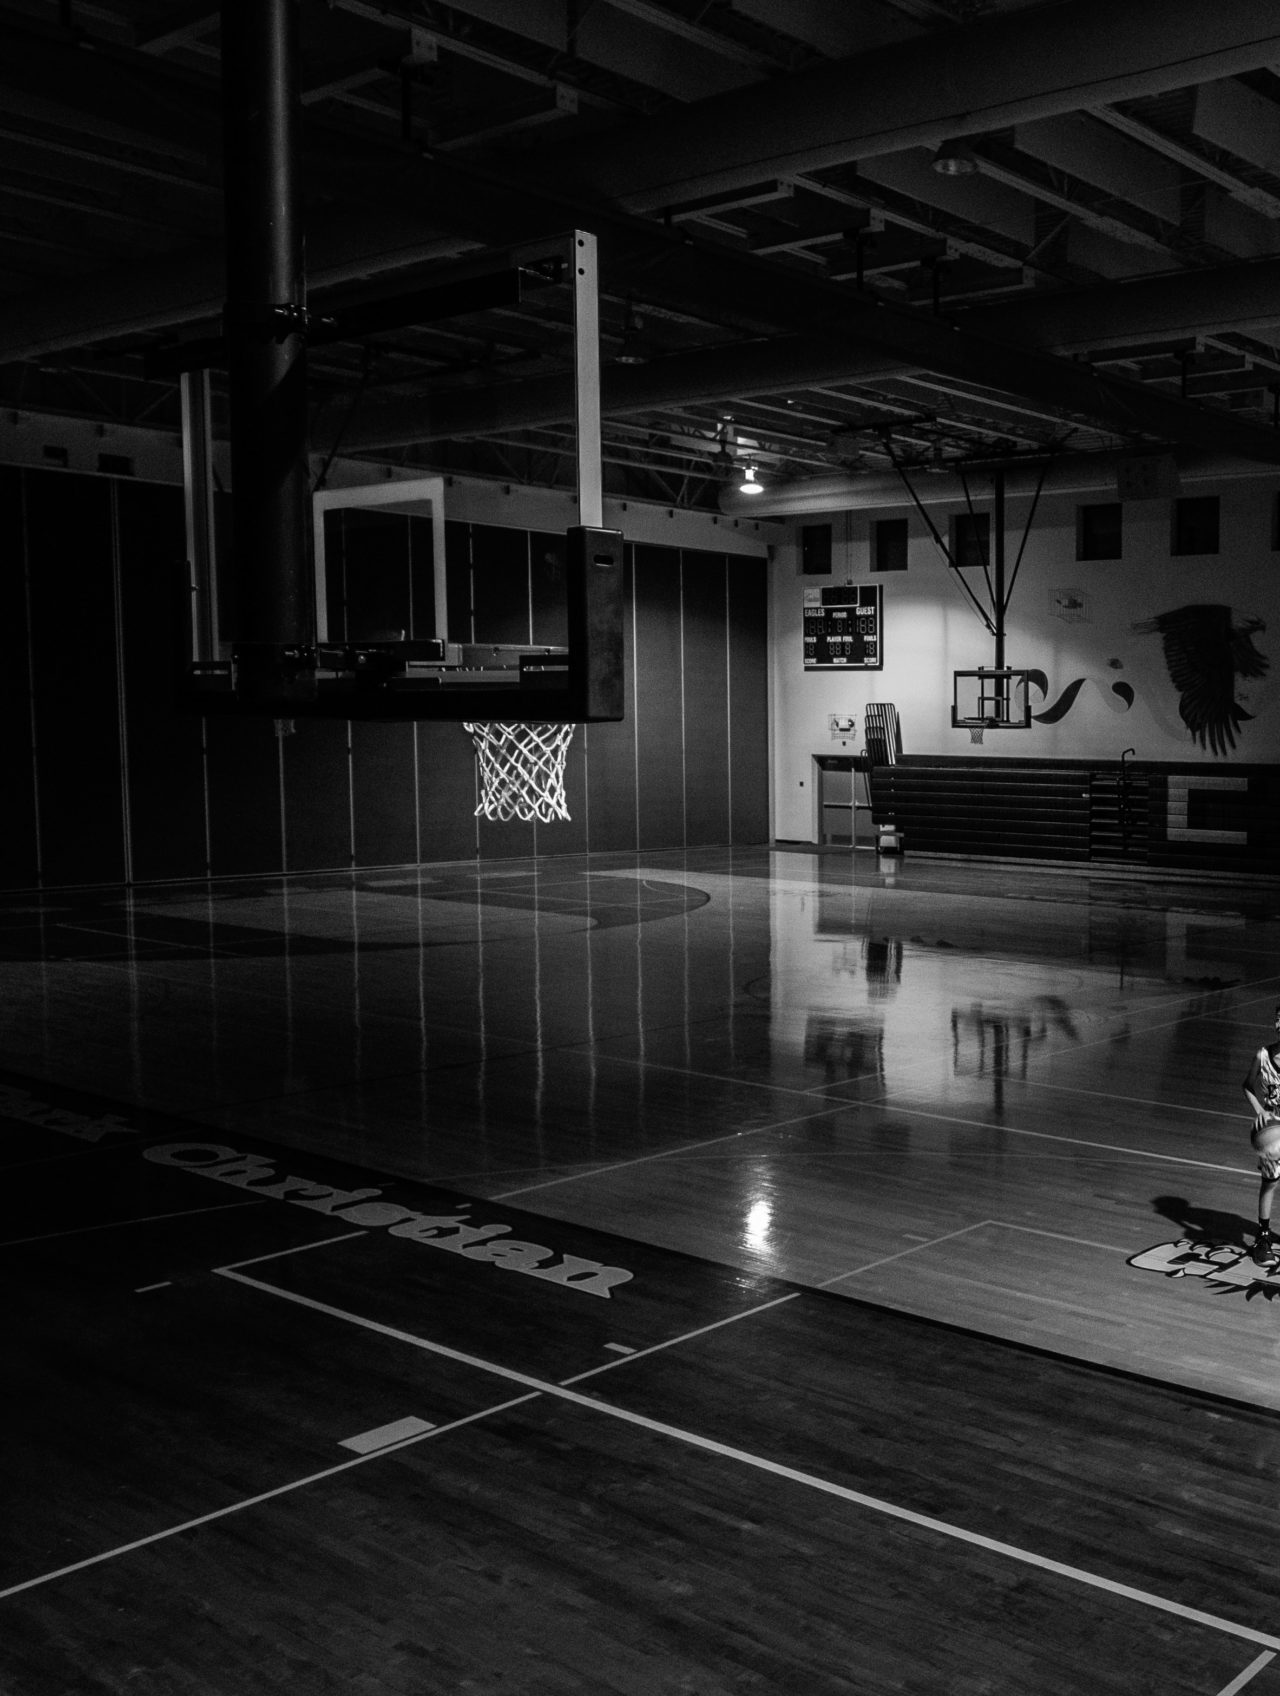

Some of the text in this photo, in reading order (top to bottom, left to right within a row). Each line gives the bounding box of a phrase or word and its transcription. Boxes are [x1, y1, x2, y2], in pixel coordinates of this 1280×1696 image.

[804, 608, 825, 617] EAGLES
[855, 606, 875, 615] GUEST
[142, 1142, 635, 1300] Christian
